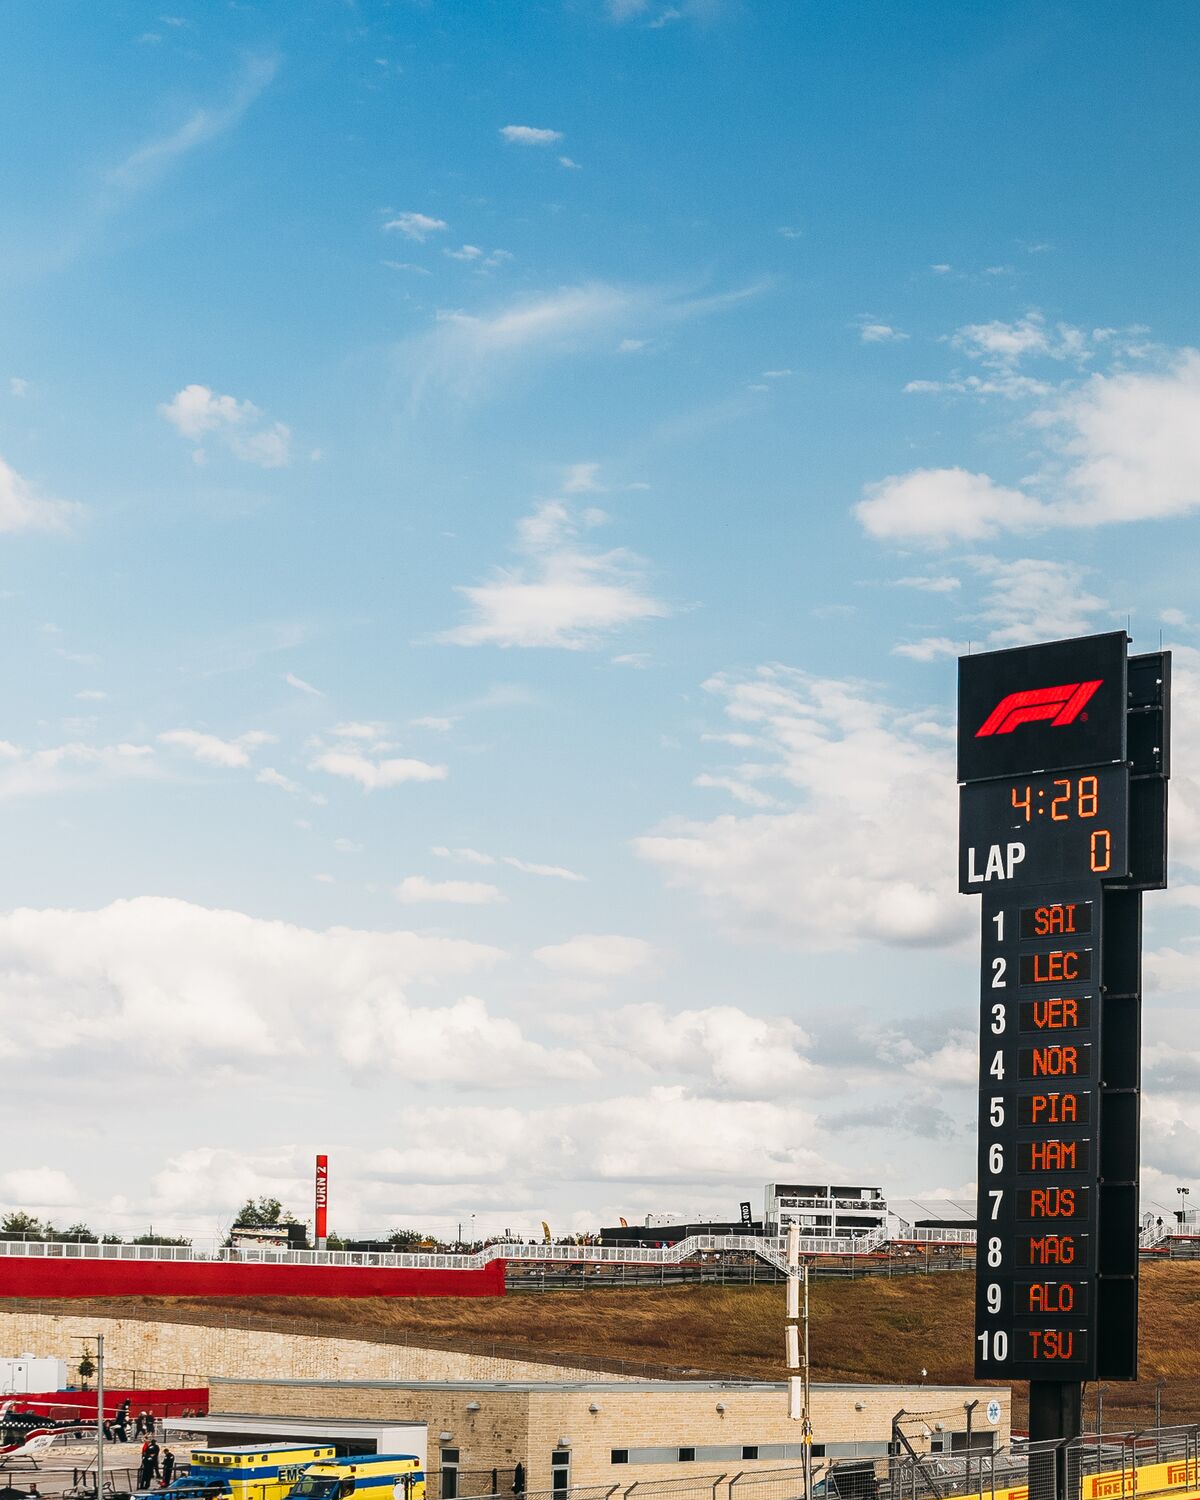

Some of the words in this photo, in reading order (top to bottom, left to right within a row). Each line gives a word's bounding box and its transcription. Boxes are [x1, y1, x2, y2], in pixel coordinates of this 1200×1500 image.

[1011, 775, 1098, 822] 4:28
[967, 842, 1026, 883] LAP
[1090, 830, 1110, 872] 0
[992, 911, 1005, 941] 1
[1035, 904, 1076, 935] SAI
[991, 957, 1007, 988] 2
[1034, 952, 1078, 982] LEC
[991, 1004, 1006, 1034] 3
[1033, 999, 1078, 1028] VER
[990, 1050, 1005, 1080] 4
[1032, 1047, 1077, 1076] NOR
[990, 1097, 1005, 1127] 5
[1032, 1094, 1076, 1123] PIA
[317, 1166, 326, 1174] 2
[989, 1143, 1004, 1174] 6
[1031, 1142, 1076, 1170] HAM
[316, 1177, 326, 1208] TURN
[988, 1190, 1004, 1220] 7
[1030, 1189, 1075, 1217] RUS
[987, 1237, 1002, 1267] 8
[1030, 1237, 1075, 1265] MAG
[986, 1284, 1002, 1314] 9
[1029, 1284, 1074, 1312] ALO
[977, 1330, 1008, 1361] 10
[1029, 1331, 1073, 1359] TSU
[1092, 1471, 1138, 1497] PIRELLI
